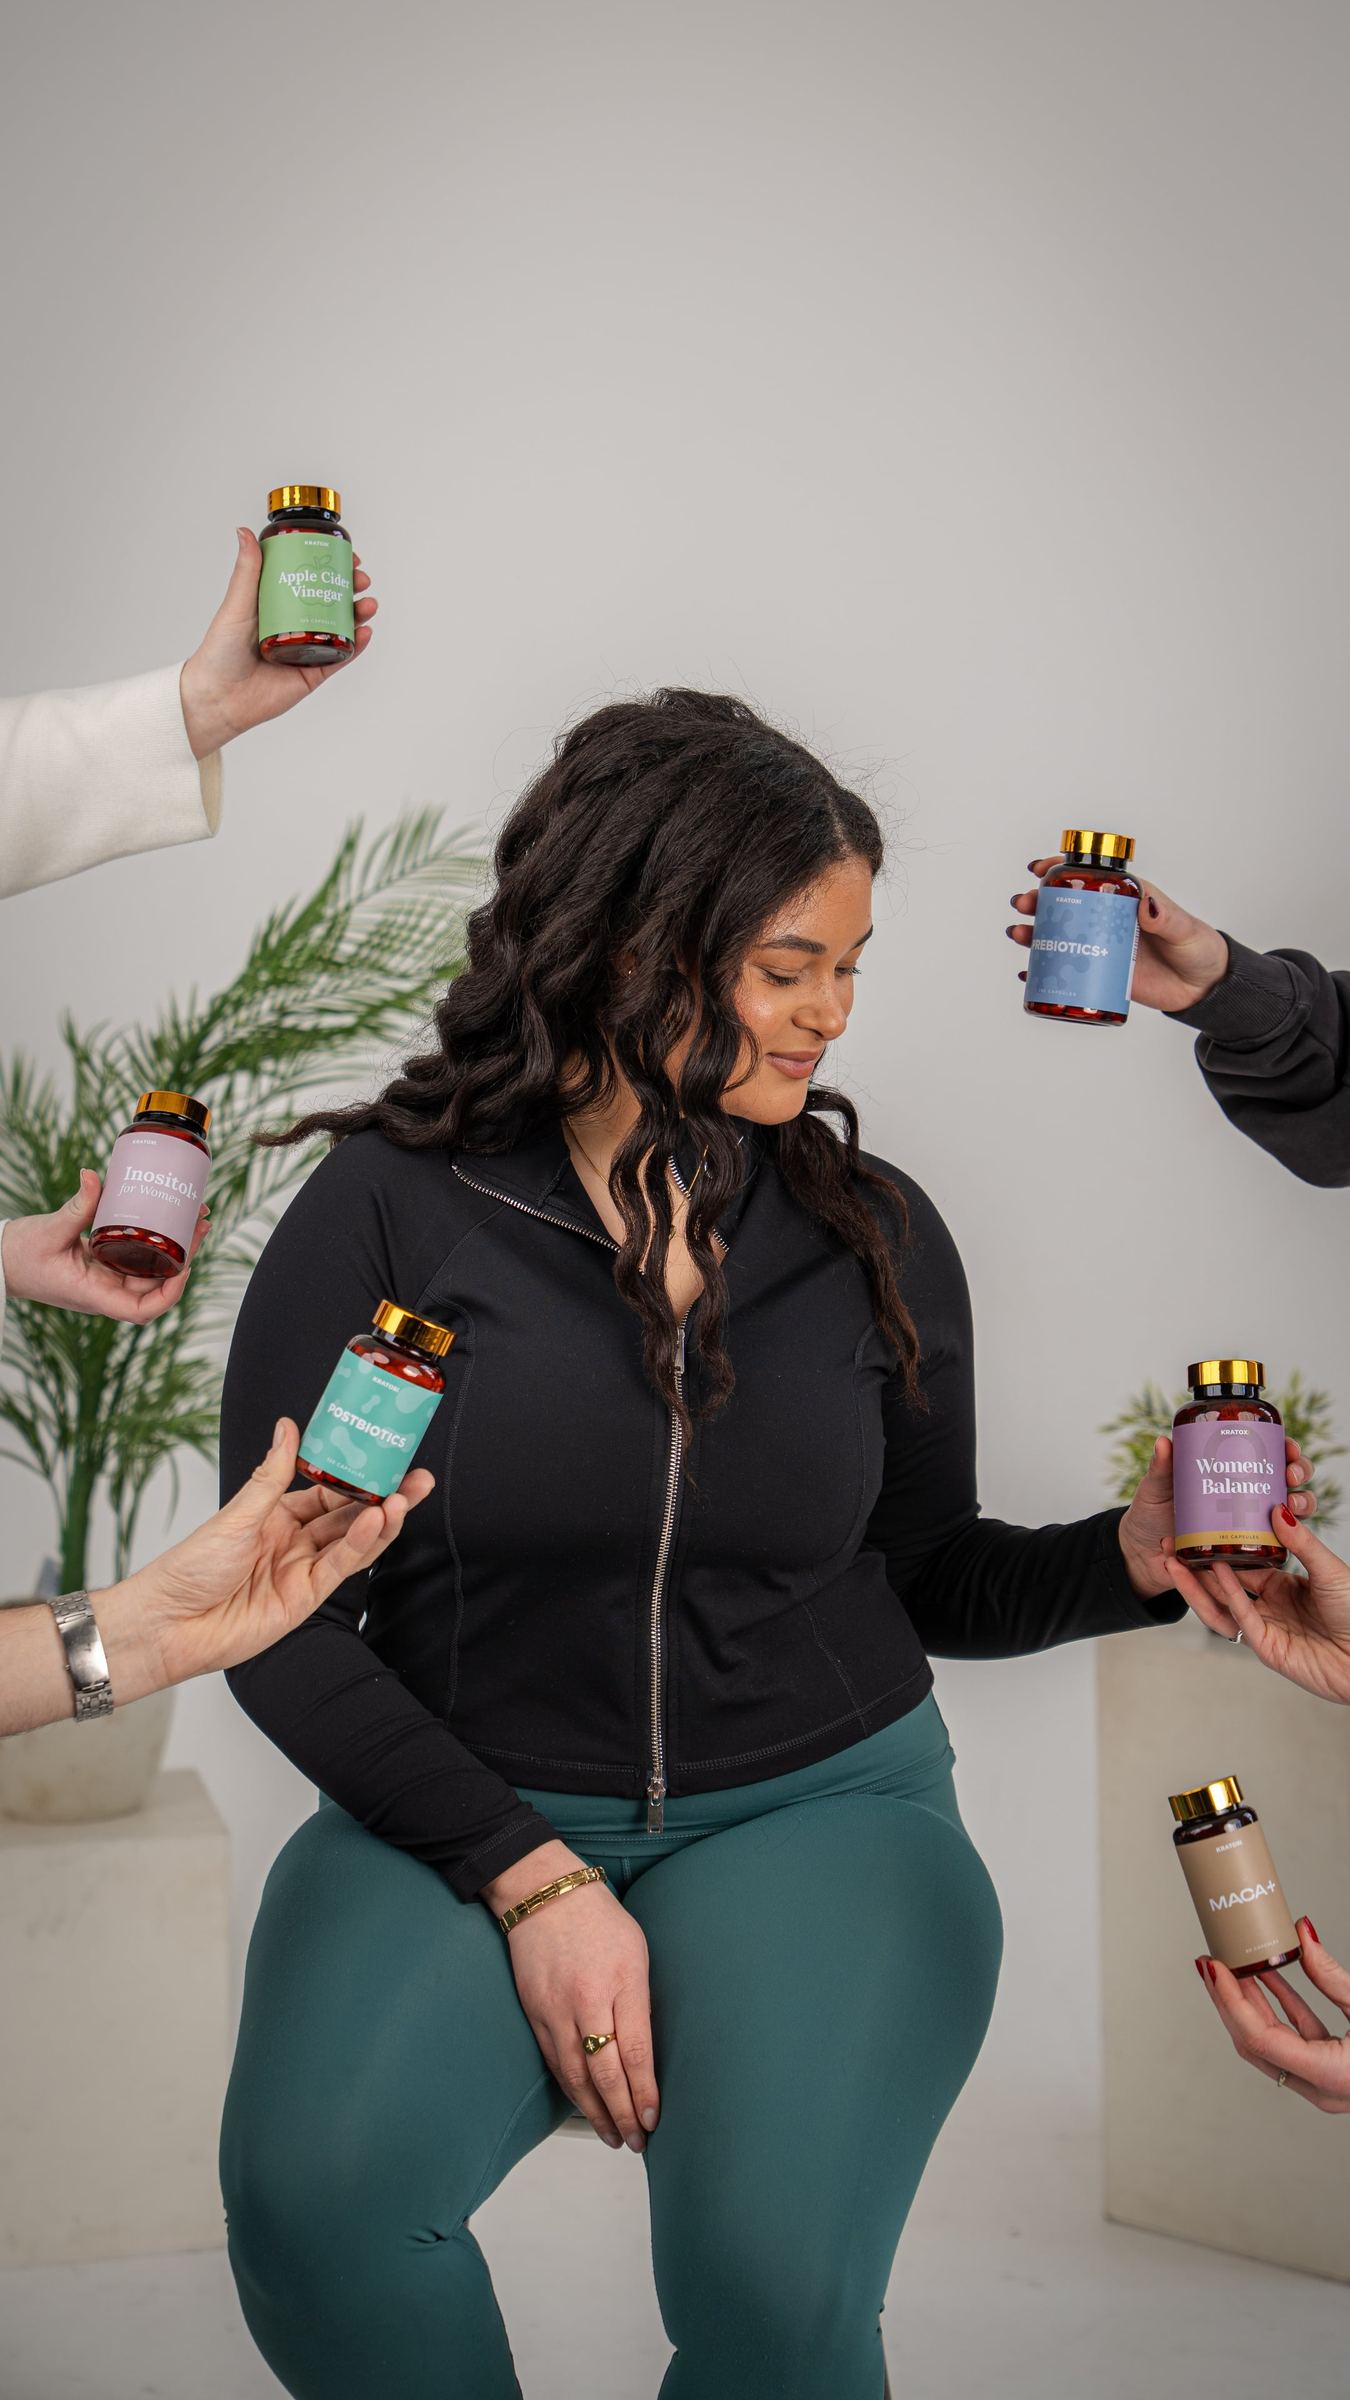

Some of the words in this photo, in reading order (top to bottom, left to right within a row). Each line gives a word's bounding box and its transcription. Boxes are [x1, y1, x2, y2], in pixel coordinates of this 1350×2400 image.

[278, 570, 317, 587] Apple
[321, 571, 350, 589] Cider
[291, 585, 344, 603] Vinegar
[118, 1182, 137, 1197] for
[139, 1184, 182, 1207] Women
[124, 1166, 199, 1201] Inositol+
[327, 1402, 408, 1449] POSTBIOTICS
[1195, 1458, 1274, 1475] Women's
[1201, 1478, 1271, 1495] Balance
[1208, 1879, 1276, 1913] MACA+
